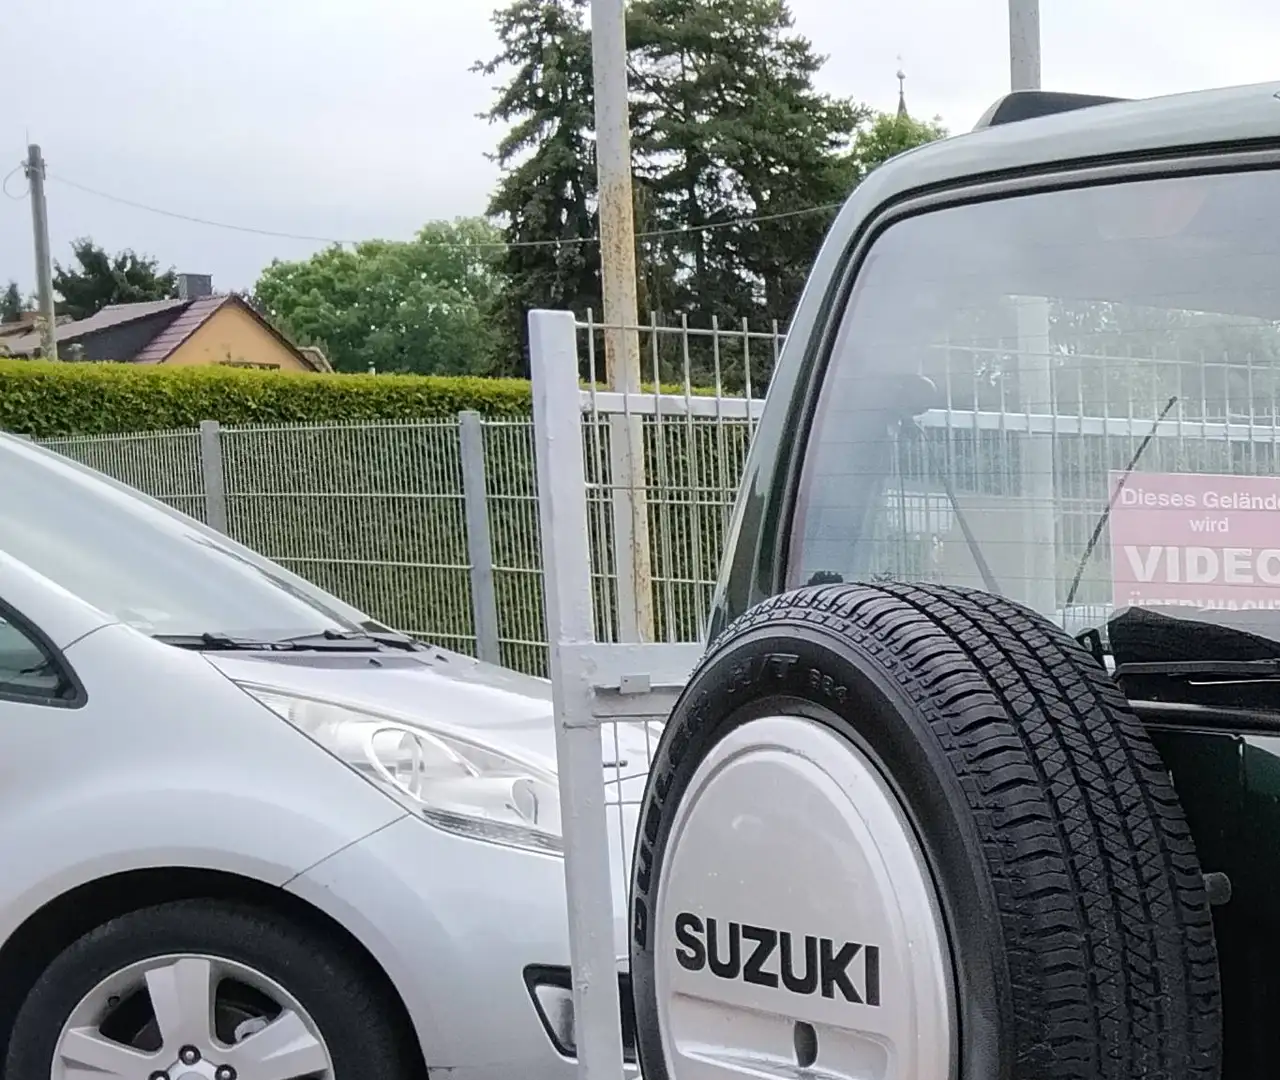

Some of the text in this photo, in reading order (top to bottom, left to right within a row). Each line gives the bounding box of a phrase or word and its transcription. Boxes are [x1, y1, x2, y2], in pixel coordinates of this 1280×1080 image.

[1121, 488, 1197, 507] Dieses
[1189, 517, 1229, 533] wird
[675, 912, 880, 1007] SUZUKI
